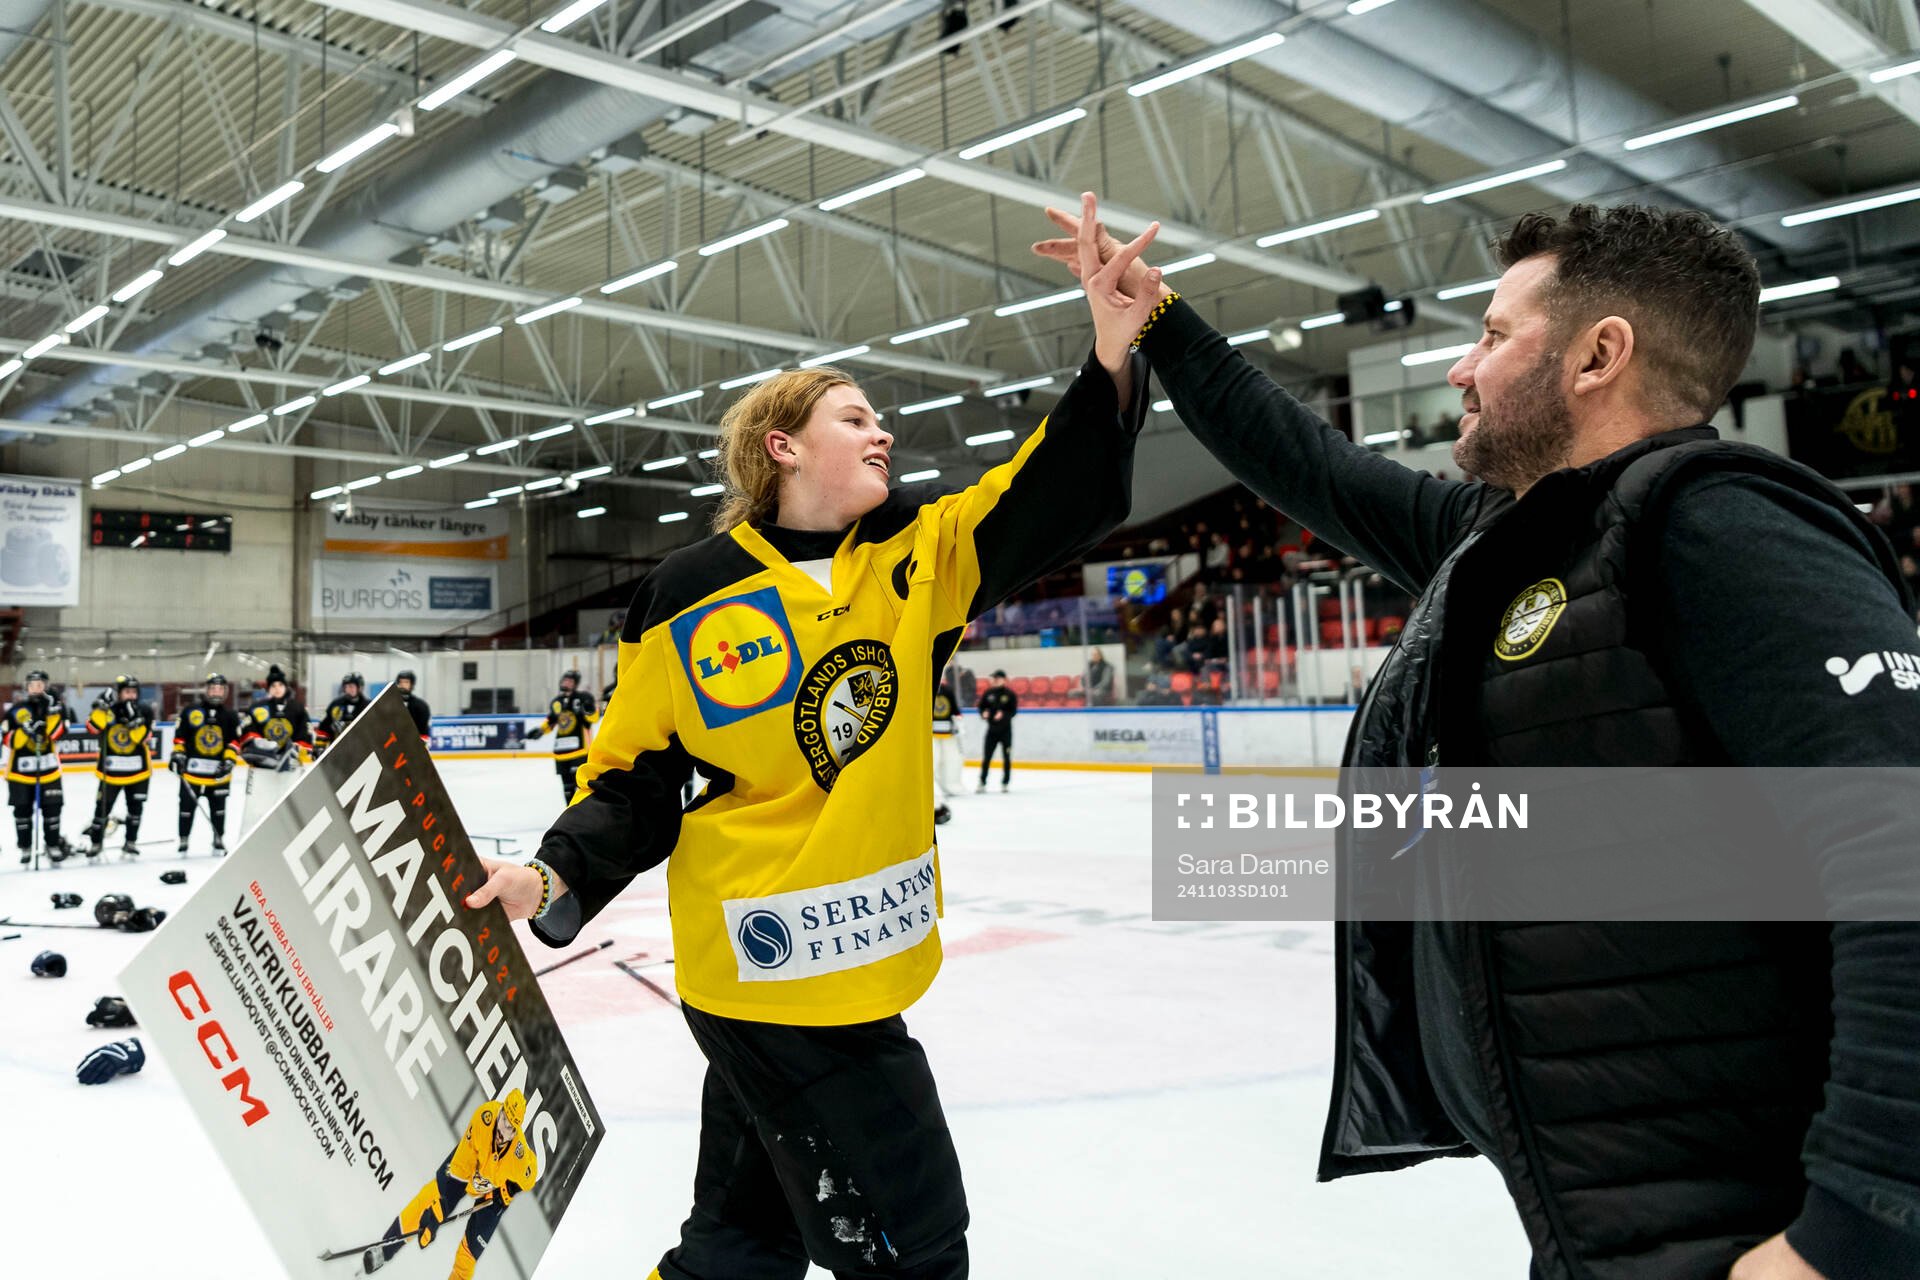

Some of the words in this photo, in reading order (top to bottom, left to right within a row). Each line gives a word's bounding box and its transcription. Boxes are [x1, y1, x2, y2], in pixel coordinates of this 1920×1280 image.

[321, 588, 423, 612] BJURFORS
[384, 514, 434, 530] tänker
[440, 516, 487, 536] längre
[832, 722, 853, 741] 19
[383, 732, 474, 911] TV-PUCKE
[478, 927, 517, 1001] 2024
[808, 904, 930, 961] FINANS
[249, 880, 266, 908] BRA
[264, 907, 295, 961] JOBBAT!
[291, 956, 304, 978] DU
[301, 974, 334, 1033] ERHÅLLER
[282, 806, 448, 1099] LIRARE
[335, 751, 558, 1182] MATCHENS
[168, 970, 270, 1128] CCM
[217, 915, 249, 966] SKICKA
[242, 961, 259, 985] ETT
[254, 982, 278, 1023] EMAIL
[274, 1019, 293, 1048] MED
[288, 1044, 304, 1071] DIN
[300, 1066, 347, 1143] BESTÄLLNING
[340, 1138, 356, 1167] TILL:
[232, 894, 284, 985] VALFRI
[275, 977, 331, 1077] KLUBBA
[324, 1066, 365, 1137] FRÅN
[358, 1129, 394, 1192] CCM
